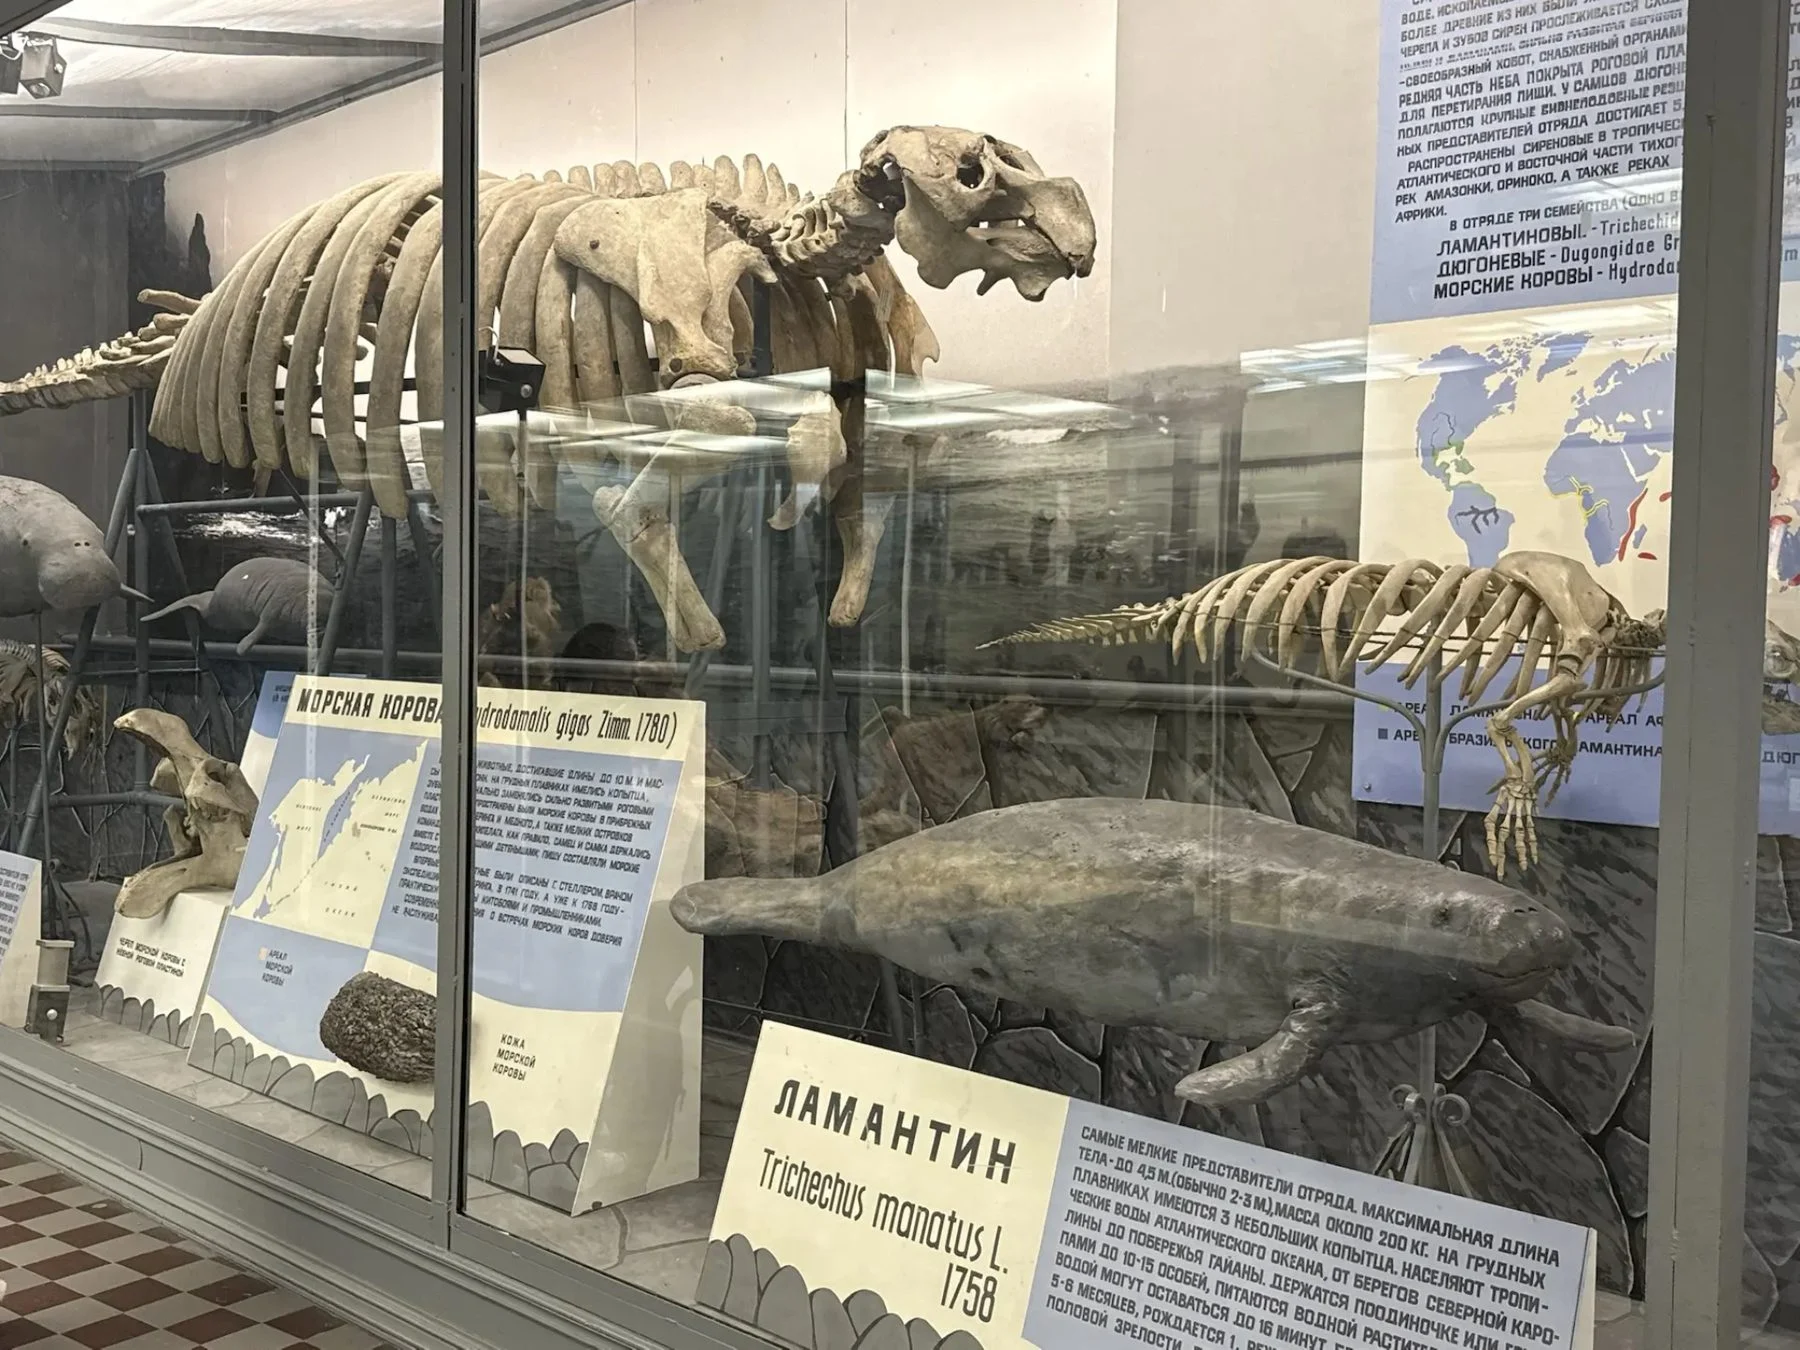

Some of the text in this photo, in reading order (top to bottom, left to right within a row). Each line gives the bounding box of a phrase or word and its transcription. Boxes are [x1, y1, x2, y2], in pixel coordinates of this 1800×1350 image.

[1400, 1, 1638, 57] ЧЕРЕПА И ЗУБОВ СИРЕН ПРОСЛЕЖИВАЕТСЯ
[1401, 8, 1434, 25] ВОДЕ.
[1401, 23, 1436, 41] БОЛЕЕ
[1442, 13, 1492, 35] ДРЕВНИЕ
[1516, 4, 1536, 19] НИХ
[1496, 51, 1534, 70] ХОБОТ,
[1539, 33, 1618, 62] СНАБЖЕННЫЙ
[1399, 48, 1647, 108] РЕДНЯЯ ЧАСТЬ НЕБА ПОКРЫТА РОГОВОЙ
[1398, 72, 1626, 125] ДЛЯ ПЕРЕТИРАНИЯ ПИЩИ. У САМЦОВ
[1398, 86, 1649, 139] ПОЛАГАЮТСЯ КРУПНЫЕ БИВНЕПОДОБНЫЕ
[1397, 101, 1666, 157] НЫХ ПРЕДСТАВИТЕЛЕЙ ОТРЯДА ДОСТИГАЕТ
[1397, 142, 1632, 191] АТЛАНТИЧЕСКОГО И ВОСТОЧНОЙ ЧАСТИ
[1408, 130, 1606, 173] РАСПРОСТРАНЕНЫ СИРЕНОВЫЕ В
[1395, 155, 1668, 206] РЕК АМАЗОНКИ, ОРИНОКО, А ТАКЖЕ РЕКАХ
[1395, 204, 1446, 224] АФРИКИ.
[1449, 218, 1456, 231] В
[1463, 211, 1513, 230] ОТРЯДЕ
[1519, 207, 1540, 222] ТРИ
[1544, 196, 1619, 219] СЕМЕЙСТВА
[1436, 237, 1654, 279] ДЮГОНЕВЫЕ Dugongidae
[1434, 258, 1678, 300] МОРСКИЕ КОРОВЫ Hydroda
[297, 688, 372, 718] МОРСКАЯ
[476, 704, 678, 750] ydrodamalis gigas Zimm. 1780)
[1394, 728, 1662, 758] АРЕ БРАЗИЬКОГО АМАНТИНА
[515, 764, 595, 782] ДОСТИГАВШИЕ ДЛИНЫ
[572, 784, 604, 797] ИМЕЛИСЬ
[536, 806, 596, 823] МОРСКИЕ КОРОВЫ
[545, 794, 654, 816] СИЛЬНО РАЗВИТЫМИ РОГОВЫМИ
[543, 821, 591, 837] ТАКЖЕ МЕЛКИХ
[553, 836, 650, 860] САМЕЦ ДЕРЖАЛИСЬ
[562, 852, 640, 874] СОСТАВЛЯЛИ МОРСКИЕ
[518, 874, 633, 903] ОПИСАНЫ ВРАЧОМ
[553, 894, 568, 906] УЖЕ
[532, 919, 622, 946] МОРСКИХ КОРОВ ДОВЕРИЯ
[265, 960, 292, 976] МОРСКОЙ
[268, 949, 288, 961] АРЕАЛ
[262, 973, 285, 987] КОРОВЫ
[497, 1047, 536, 1069] МОРСКОЙ
[501, 1033, 525, 1049] КОЖА
[492, 1063, 528, 1082] КОРОВЫ
[773, 1079, 1016, 1184] ЛАМАНТИН
[759, 1148, 1009, 1274] Trichechus manatus L.
[1081, 1125, 1559, 1267] САМЫЕ МЕЛКИЕ ПРЕДСТАВИТЕЛИ ОТРЯДА. МАКСИМАЛЬНАЯ ДЛИНА
[1073, 1167, 1547, 1316] ПЛАВНИКАХ ИМЕЮТСЯ 3 НЕБОЛЬШИХ КОПЫТЦА. НАСЕЛЯЮТ ТРОПИ-
[1326, 1216, 1372, 1242] ОКОЛО
[1378, 1230, 1406, 1251] 200
[1410, 1239, 1428, 1257] КГ.
[1437, 1246, 1458, 1265] НА
[1465, 1254, 1545, 1289] ГРУДНЫХ
[1059, 1231, 1357, 1339] ПАМИ ДО 10-15 ОСОБЕЙ, ПИТАЮТСЯ ВОДНОЙ
[1064, 1209, 1458, 1343] ЛИНЫ ДО ПОБЕРЕЖЬЯ ГАЙАНЫ. ДЕРЖАТСЯ ПООДИНОЧКЕ
[1070, 1188, 1559, 1347] ЧЕСКИЕ ВОДЫ АТЛАНТИЧЕСКОГО ОКЕАНА, ОТ БЕРЕГОВ СЕВЕРНОЙ КАРО-
[941, 1262, 998, 1324] 1758
[1055, 1252, 1254, 1331] ВОДОЙ МОГУТ ОСТАВАТЬСЯ ДО
[1046, 1294, 1181, 1350] ПОЛОВОЙ ЗРЕЛОСТИ
[1077, 1282, 1139, 1318] МЕСЯЦЕВ,
[1142, 1305, 1224, 1345] РОЖДАЕТСЯ
